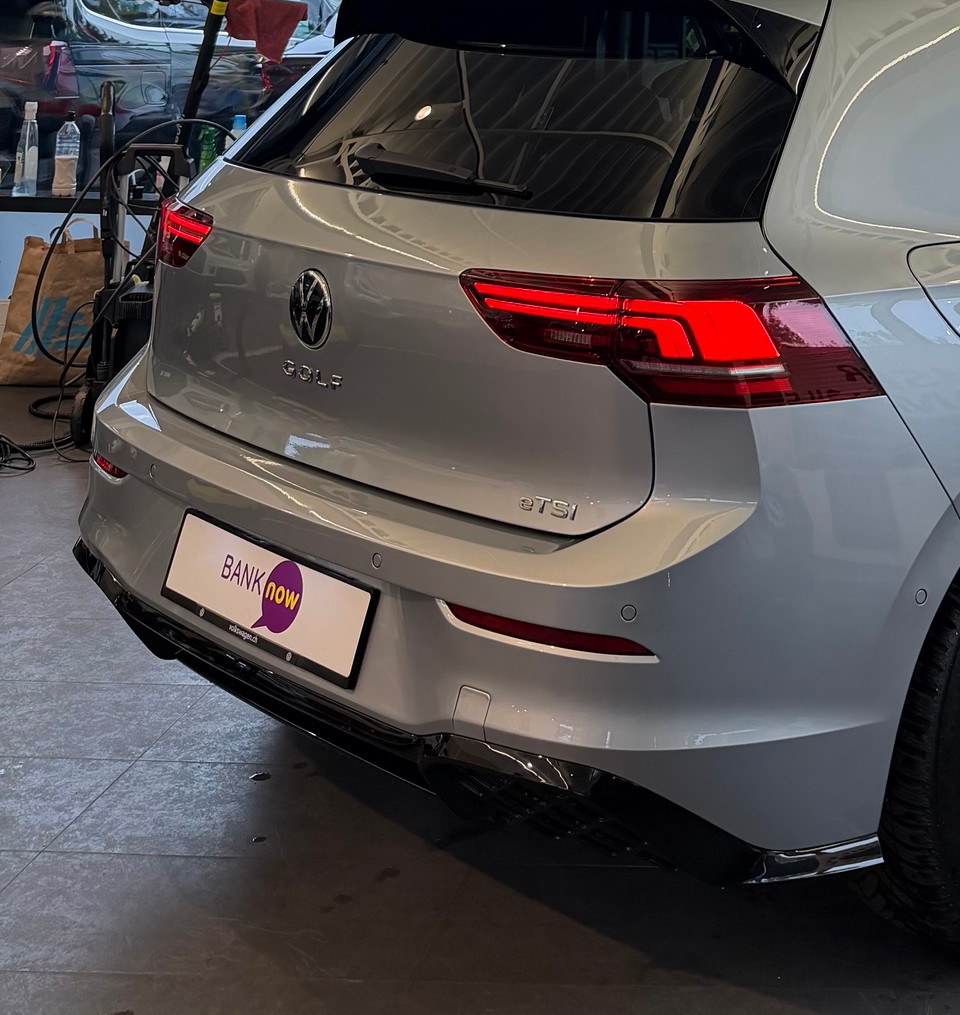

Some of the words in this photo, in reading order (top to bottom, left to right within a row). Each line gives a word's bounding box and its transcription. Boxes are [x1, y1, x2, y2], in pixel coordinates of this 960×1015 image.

[282, 359, 343, 390] GOLF
[519, 495, 578, 521] eTSI
[220, 554, 266, 596] BANK
[264, 581, 300, 611] now
[228, 624, 259, 644] volkswagen.ch
